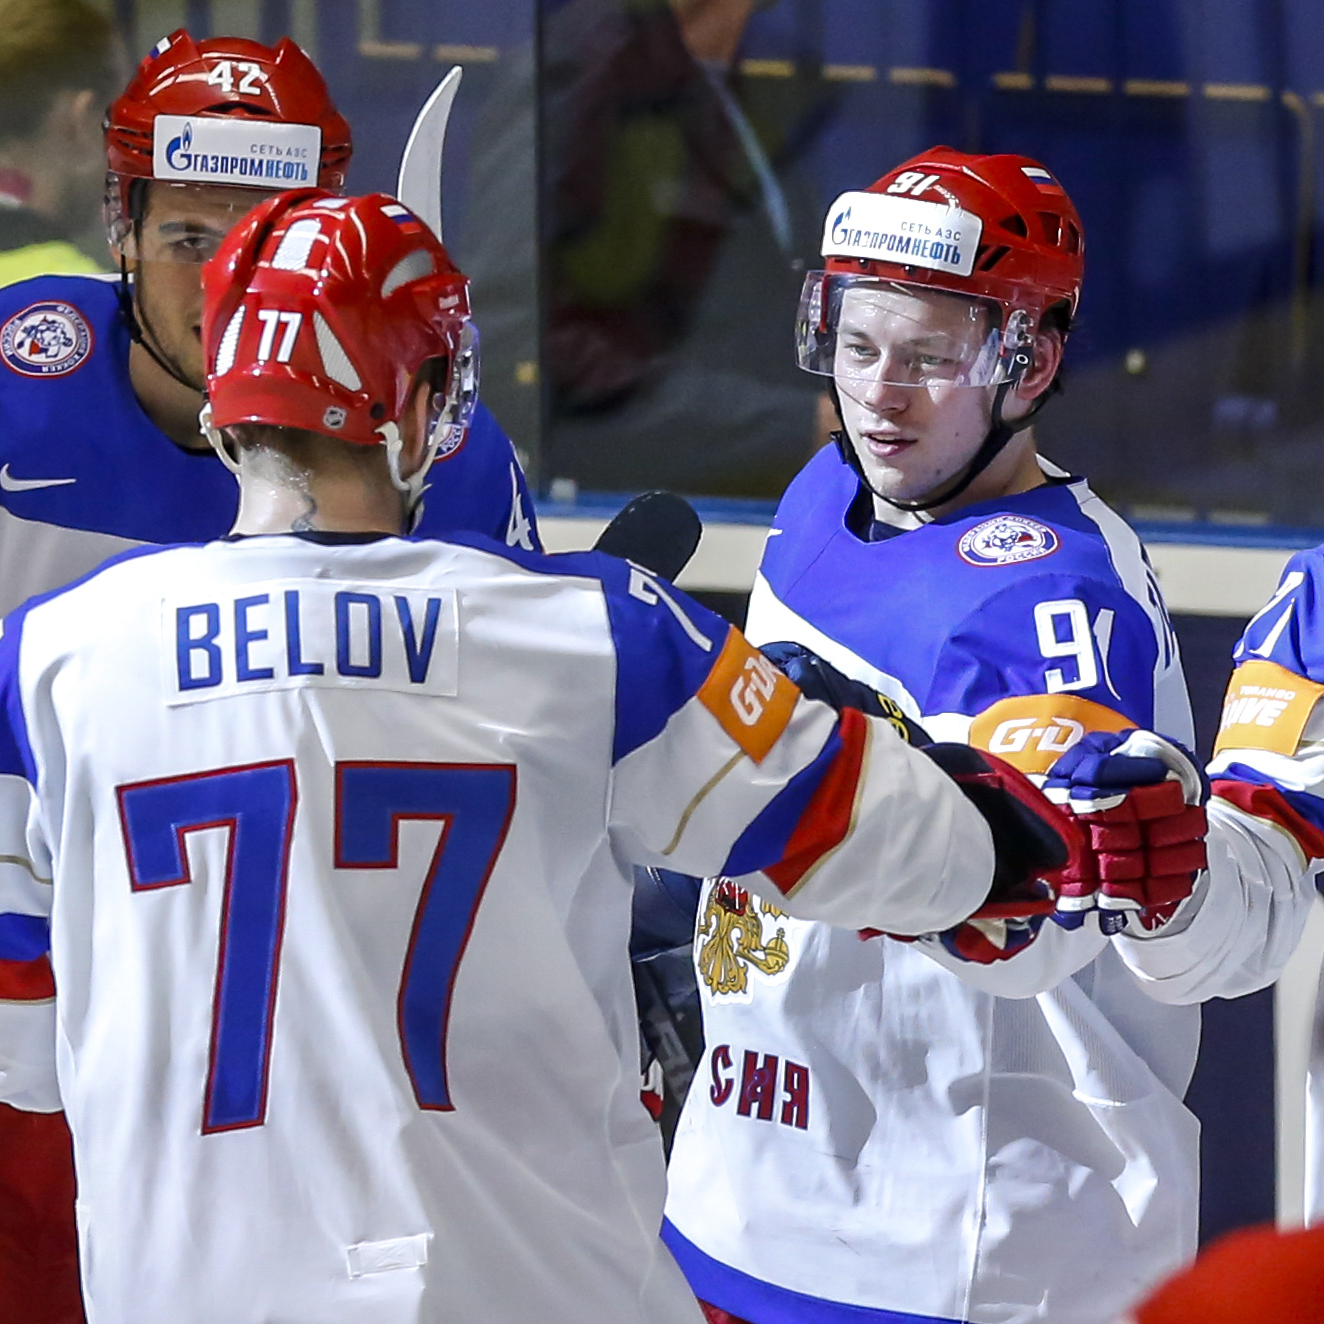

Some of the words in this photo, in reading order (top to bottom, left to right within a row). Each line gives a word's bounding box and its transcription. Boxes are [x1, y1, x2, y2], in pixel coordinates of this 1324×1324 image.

[208, 60, 262, 96] 42
[192, 152, 309, 181] ГАЗПРОМНЕФТЬ
[250, 142, 282, 156] СЕТЬ
[887, 171, 941, 196] 91
[846, 228, 961, 265] ГАЗПРОМНЕФТЬ
[900, 221, 932, 236] СЕТЬ
[934, 226, 962, 242] АЗС
[256, 308, 303, 363] 77
[176, 590, 442, 693] BELOV
[114, 758, 518, 1136] 77
